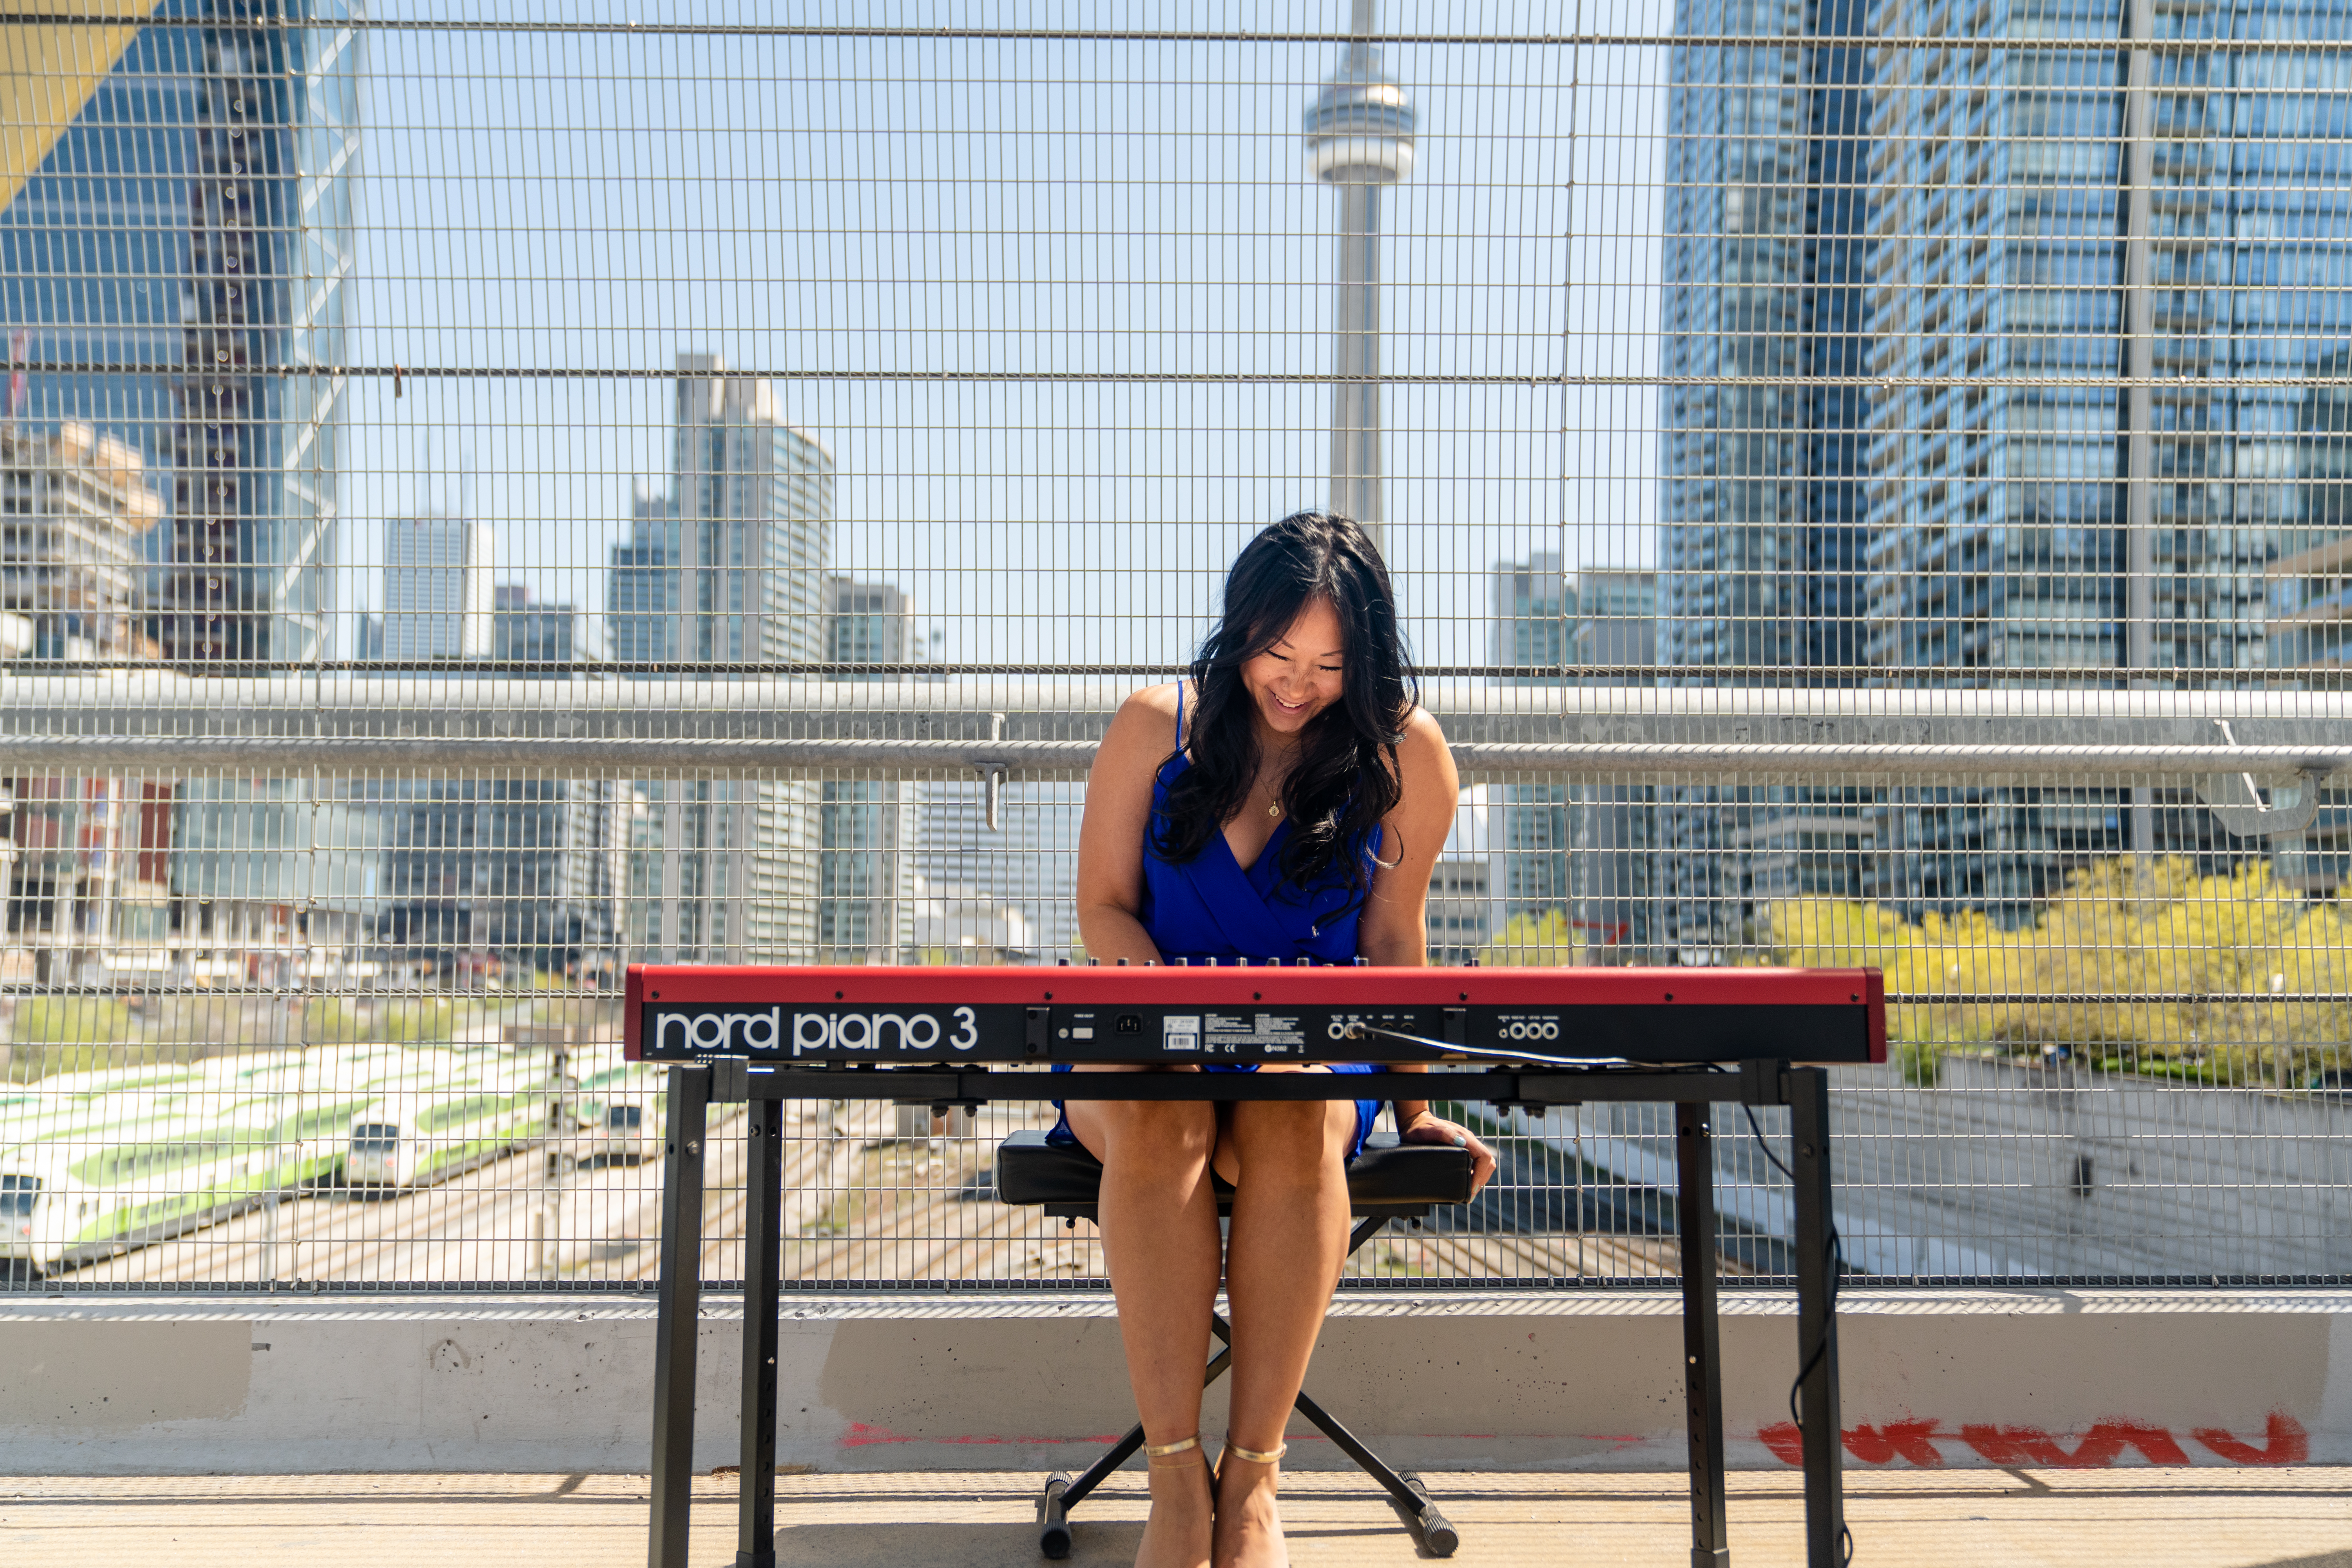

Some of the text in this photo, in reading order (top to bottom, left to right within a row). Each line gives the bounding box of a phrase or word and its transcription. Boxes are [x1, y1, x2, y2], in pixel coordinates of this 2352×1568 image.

[656, 1006, 978, 1056] nord piano 3
